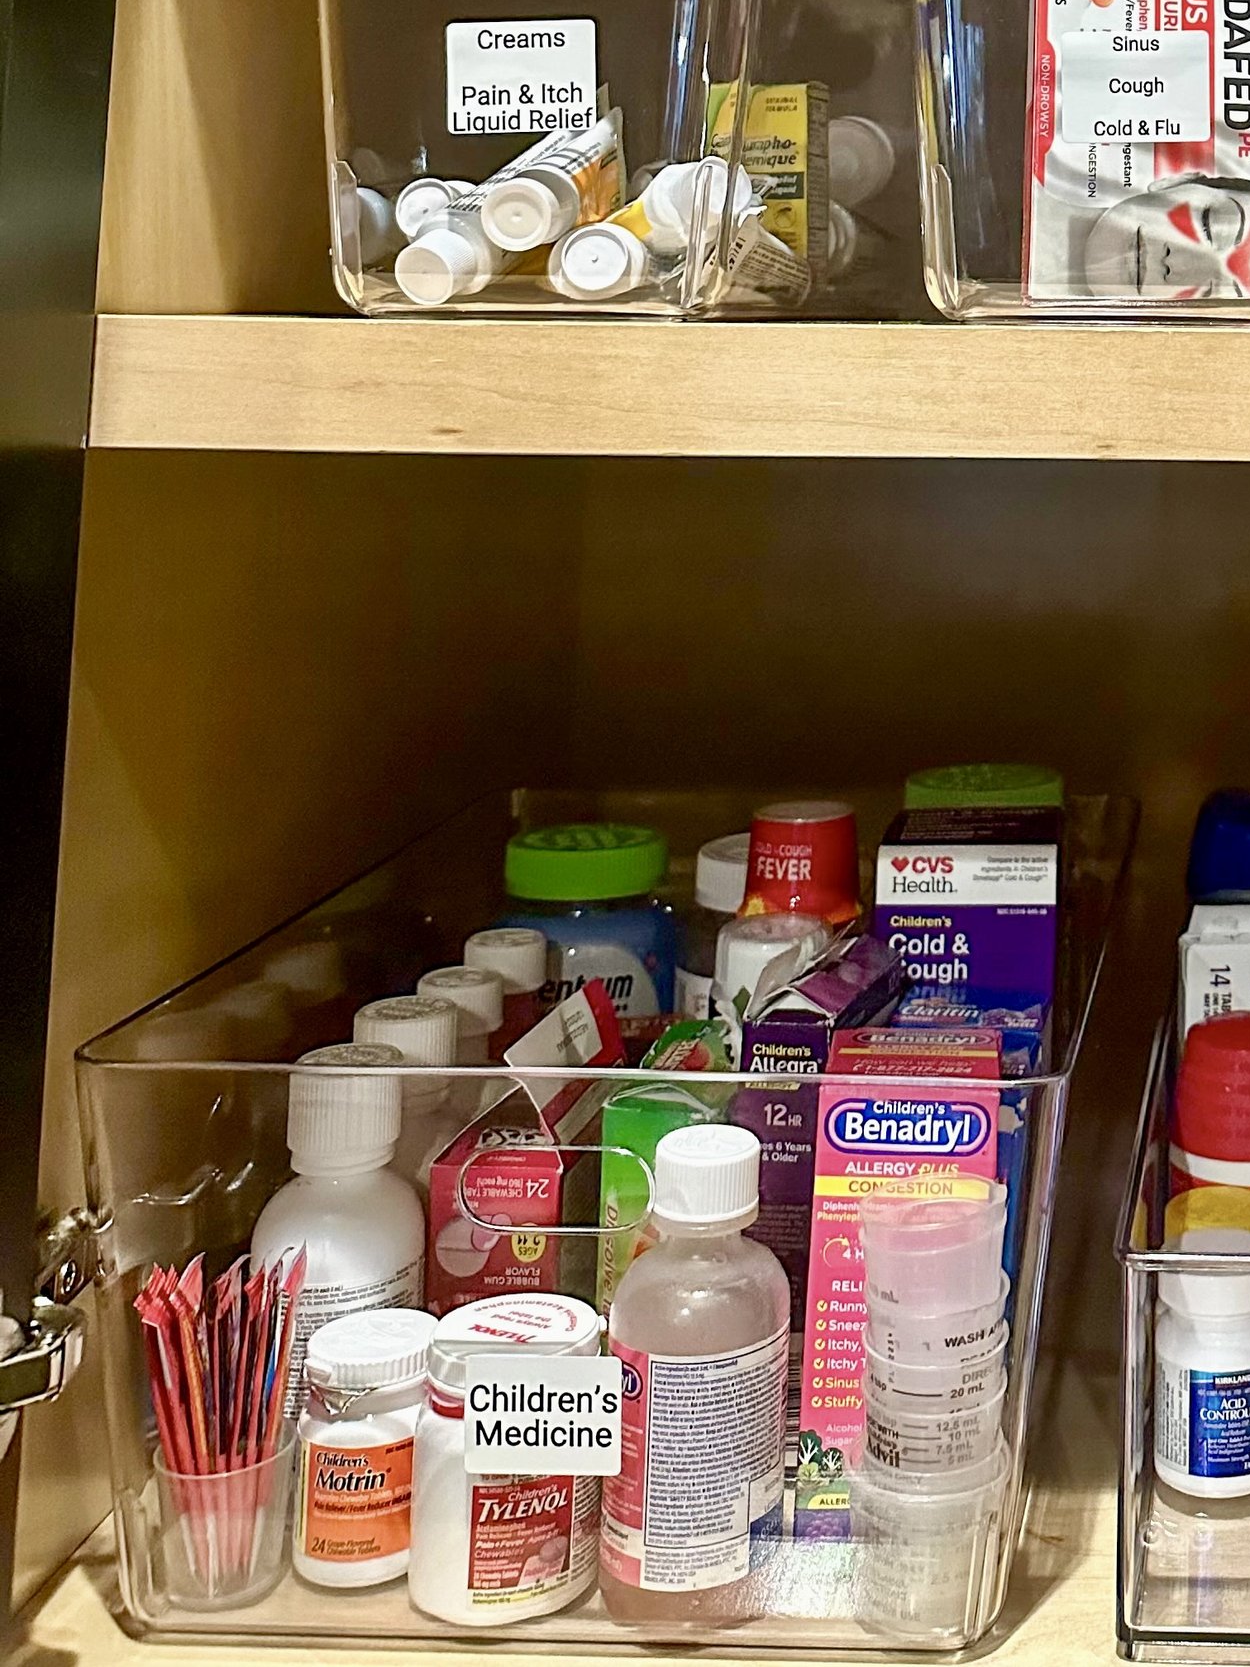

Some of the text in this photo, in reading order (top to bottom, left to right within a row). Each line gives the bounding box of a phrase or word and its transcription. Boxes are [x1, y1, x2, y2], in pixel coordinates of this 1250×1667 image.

[477, 28, 567, 50] Creams
[1112, 36, 1160, 53] Sinus
[461, 81, 584, 106] Pain & Itch
[1039, 54, 1051, 138] NON-DROWSY
[1108, 78, 1164, 96] Cough
[452, 107, 594, 133] Liquid Relief
[1094, 119, 1180, 136] Cold & Flu
[756, 855, 812, 881] FEVER
[912, 856, 954, 874] CVS
[892, 876, 953, 893] Health
[890, 915, 952, 927] Children's
[888, 932, 970, 955] Cold &
[1210, 964, 1232, 987] 14
[752, 1043, 812, 1056] Children's
[764, 1103, 788, 1127] 12
[873, 1101, 946, 1114] Children's
[844, 1111, 971, 1152] Benadryl
[784, 1143, 812, 1153] Years
[771, 1152, 799, 1163] Older
[844, 1161, 917, 1175] ALLERGY
[526, 1178, 550, 1199] 24
[943, 1329, 986, 1348] WASH
[826, 1357, 857, 1370] Itchy
[825, 1377, 860, 1388] Sinus
[950, 1382, 985, 1399] 20 mL
[469, 1383, 618, 1414] Children's
[824, 1396, 864, 1410] Stuffy
[1220, 1397, 1247, 1410] ACID
[475, 1418, 613, 1448] Medicine
[316, 1451, 369, 1468] Children's
[315, 1468, 386, 1492] Motrin
[507, 1484, 558, 1502] Children's
[477, 1487, 568, 1523] TYLENOL
[311, 1536, 326, 1554] 24
